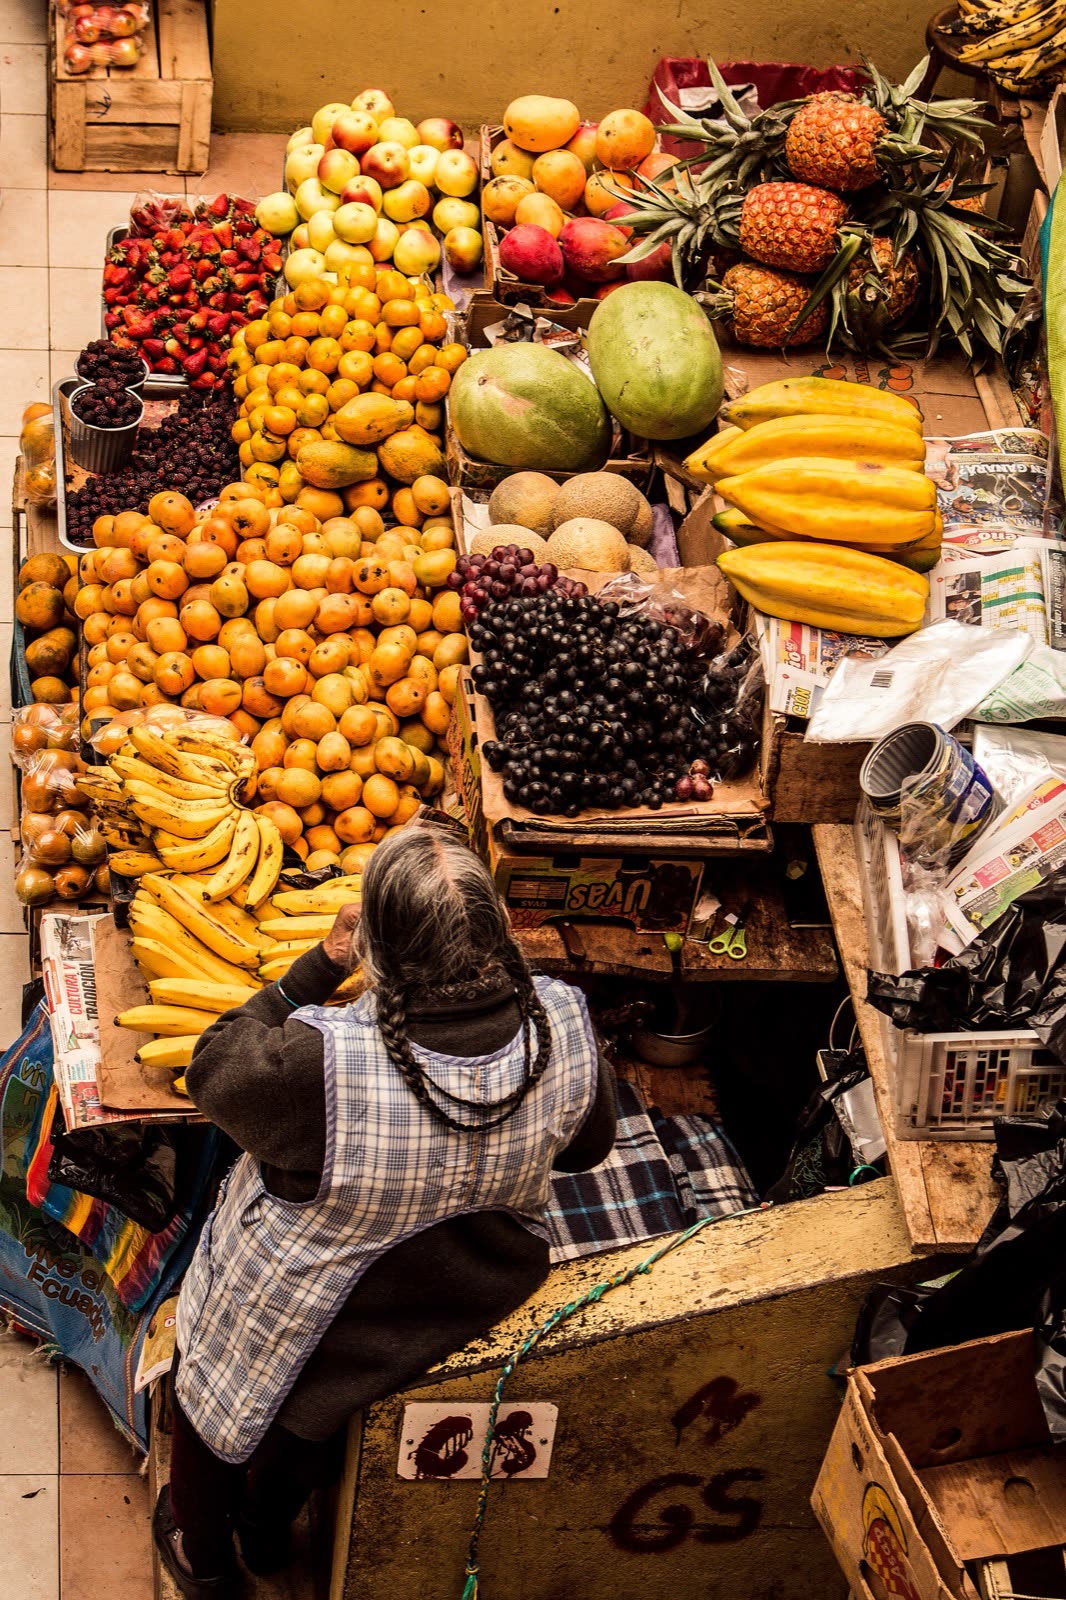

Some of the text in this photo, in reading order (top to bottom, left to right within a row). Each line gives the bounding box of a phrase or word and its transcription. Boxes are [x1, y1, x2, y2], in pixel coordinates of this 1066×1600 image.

[959, 463, 1028, 476] GANARÁ?
[521, 900, 548, 908] UVAS
[568, 878, 652, 914] Uvas
[64, 973, 82, 1015] CULTURA
[77, 963, 99, 1020] TRADICIÓN
[81, 1269, 109, 1296] el
